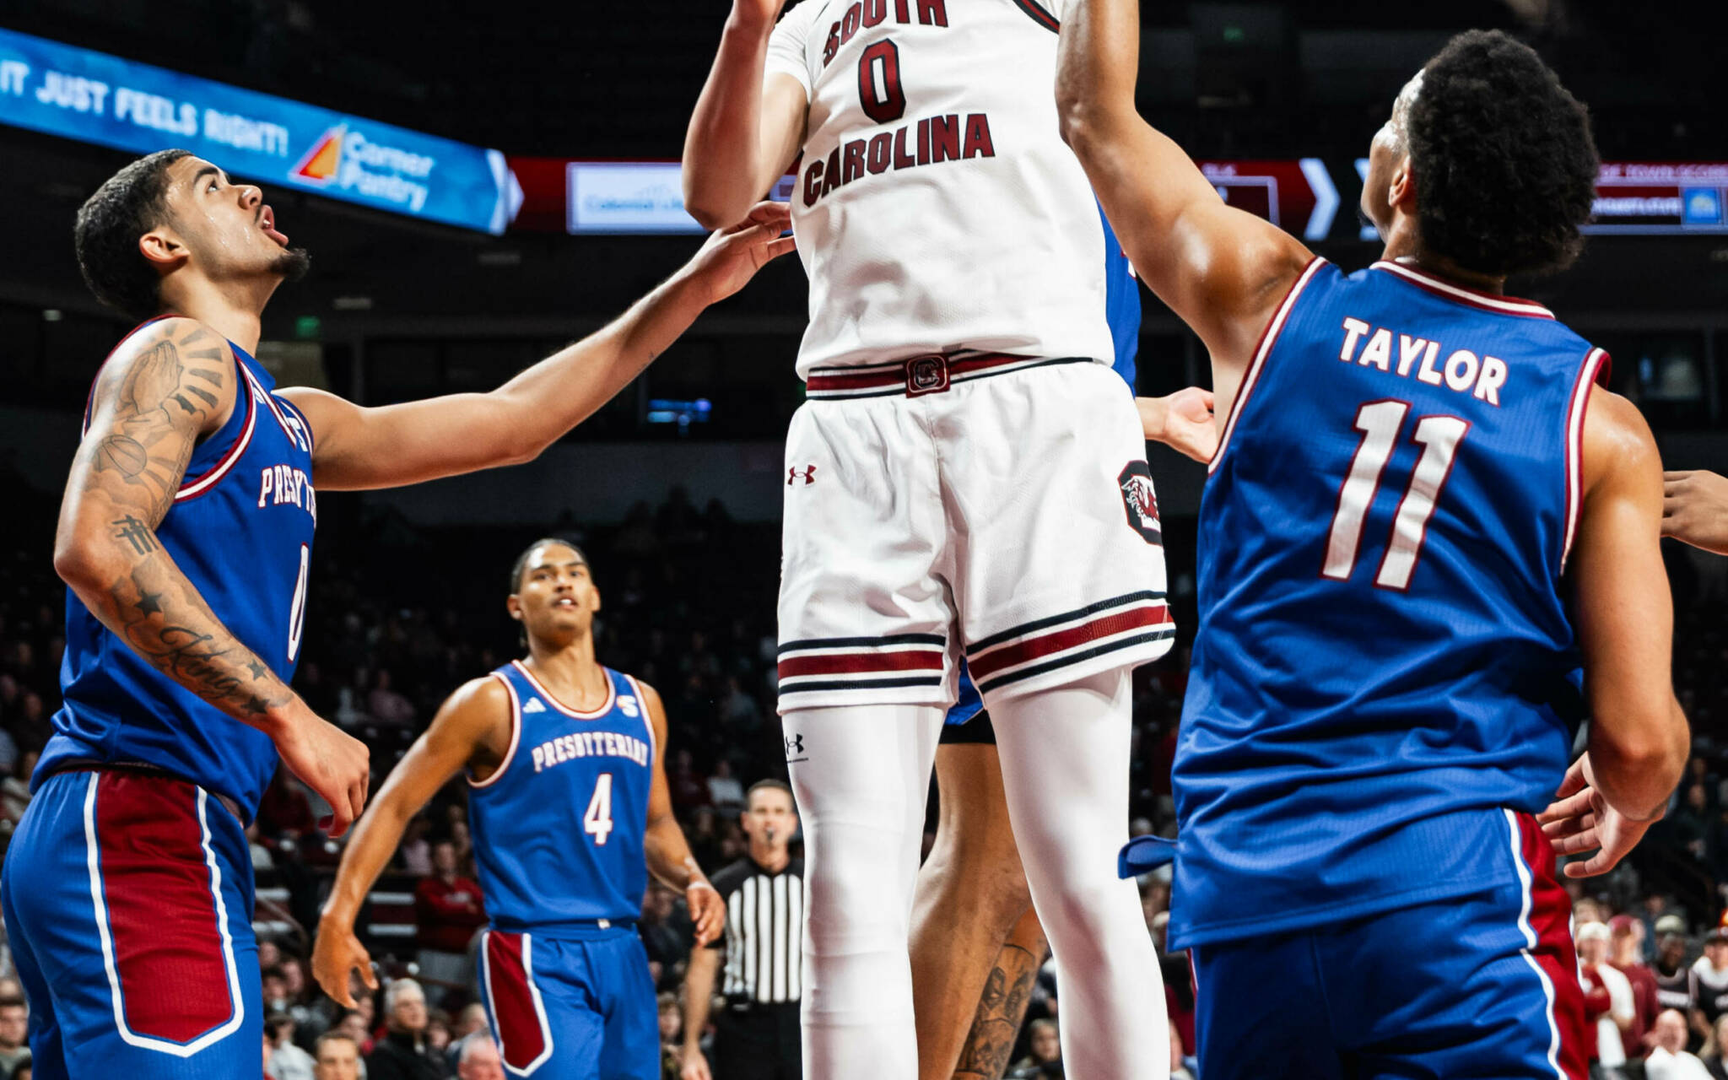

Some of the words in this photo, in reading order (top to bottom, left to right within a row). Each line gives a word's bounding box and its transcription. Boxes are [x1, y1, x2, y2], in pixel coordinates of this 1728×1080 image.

[35, 70, 109, 114] JUST
[114, 86, 197, 137] FEELS
[203, 108, 289, 158] RIGHT!
[858, 38, 906, 124] 0
[340, 160, 428, 212] Pantry
[345, 131, 436, 177] Corner
[803, 113, 995, 208] CAROLINA
[1339, 316, 1508, 407] TAYLOR
[1319, 397, 1472, 593] 11
[287, 542, 309, 663] 0
[531, 731, 649, 773] PRESBYTERIAN
[583, 772, 613, 847] 4
